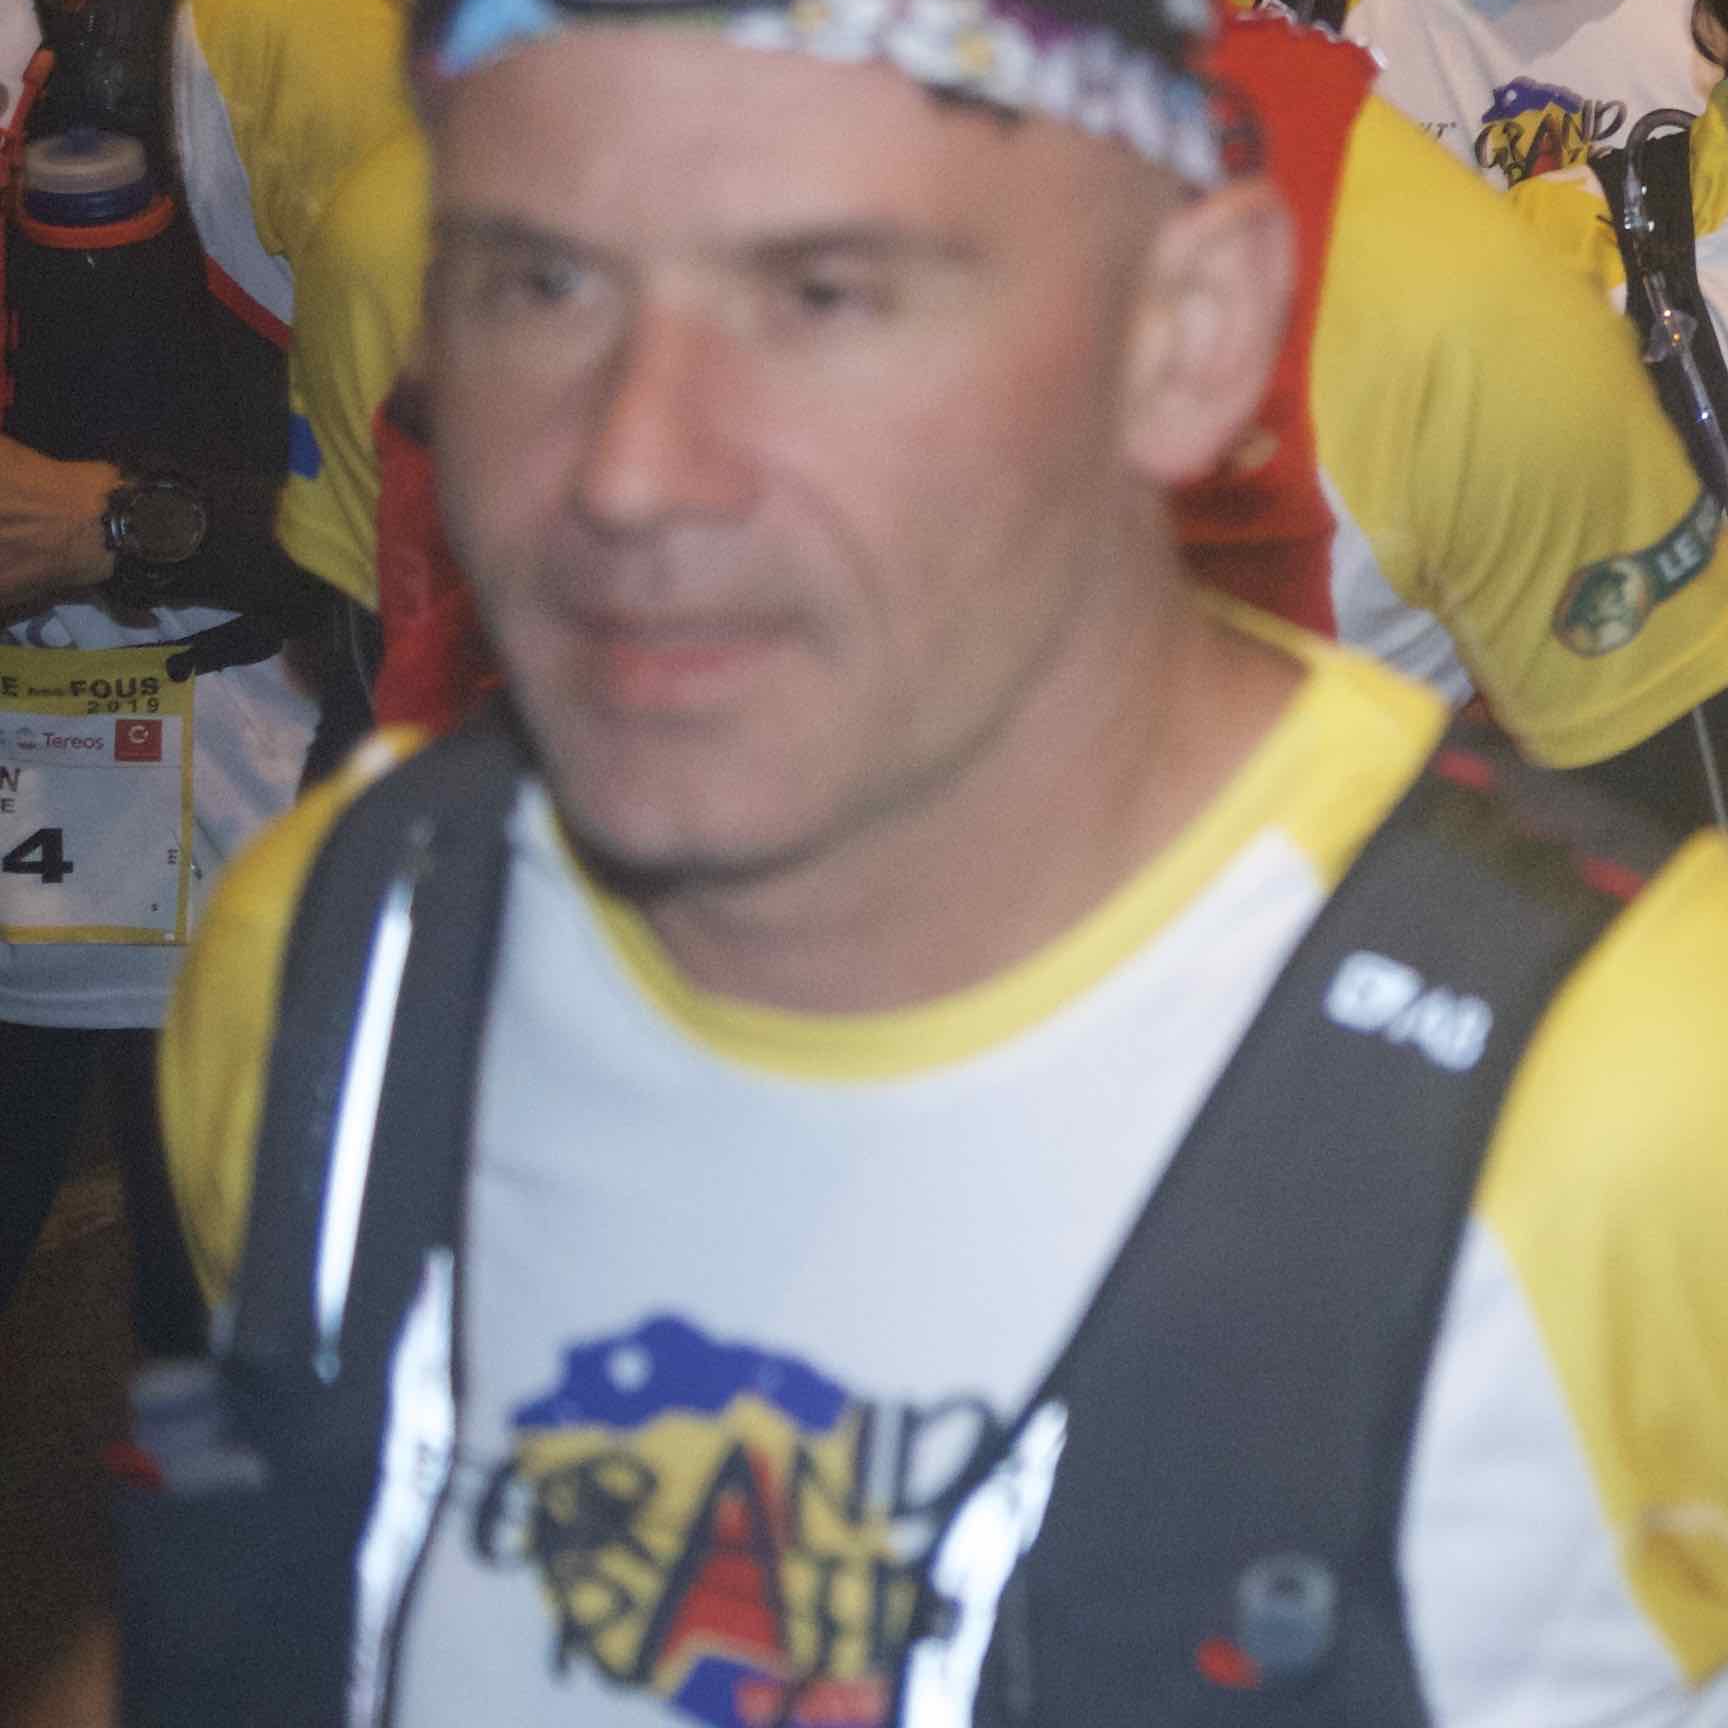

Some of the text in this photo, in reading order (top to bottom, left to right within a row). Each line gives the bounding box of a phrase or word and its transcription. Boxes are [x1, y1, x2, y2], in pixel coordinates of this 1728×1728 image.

[69, 677, 161, 697] FOUS
[87, 699, 160, 714] 2019
[41, 732, 105, 752] Tereos
[2, 827, 74, 884] 4
